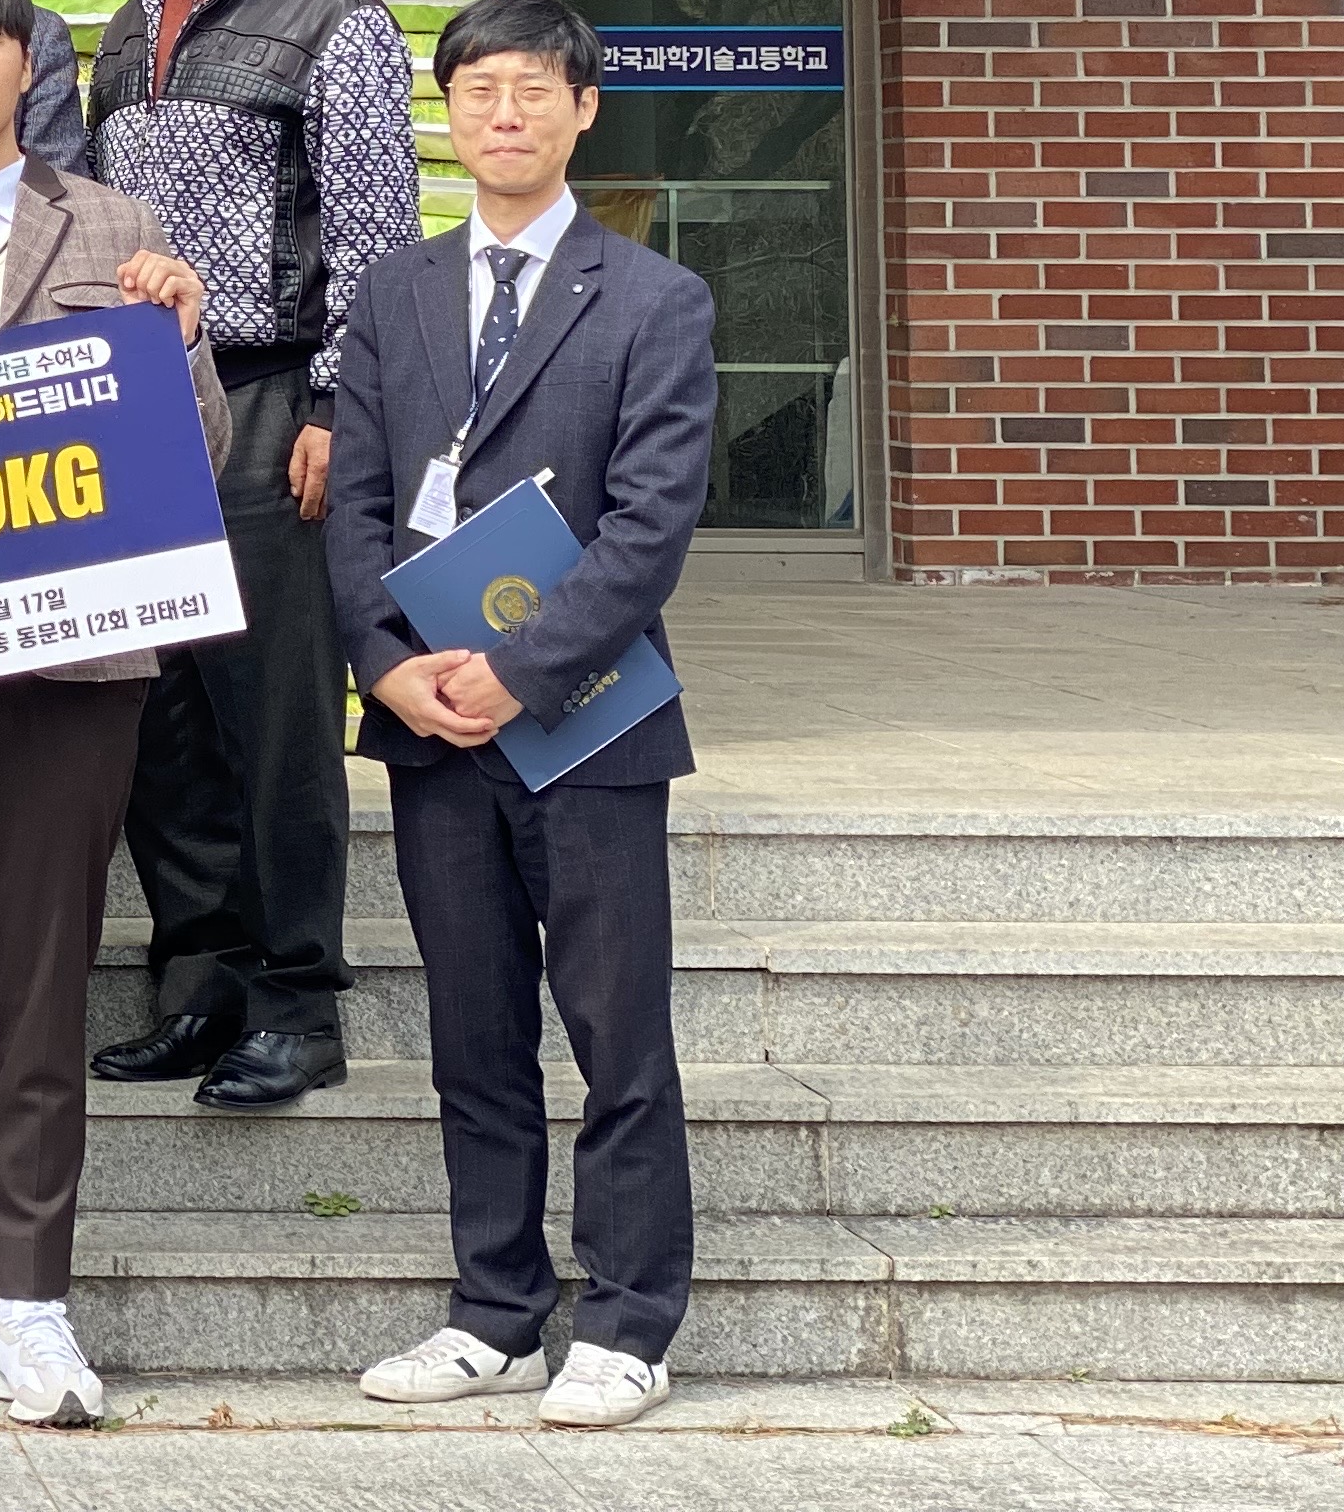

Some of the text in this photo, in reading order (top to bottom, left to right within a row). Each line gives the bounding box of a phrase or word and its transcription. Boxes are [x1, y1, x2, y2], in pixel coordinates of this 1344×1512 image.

[604, 45, 828, 71] 한국과학기술고등학교
[35, 344, 95, 374] 수여식
[20, 587, 67, 616] 17일
[16, 620, 79, 651] 동문회
